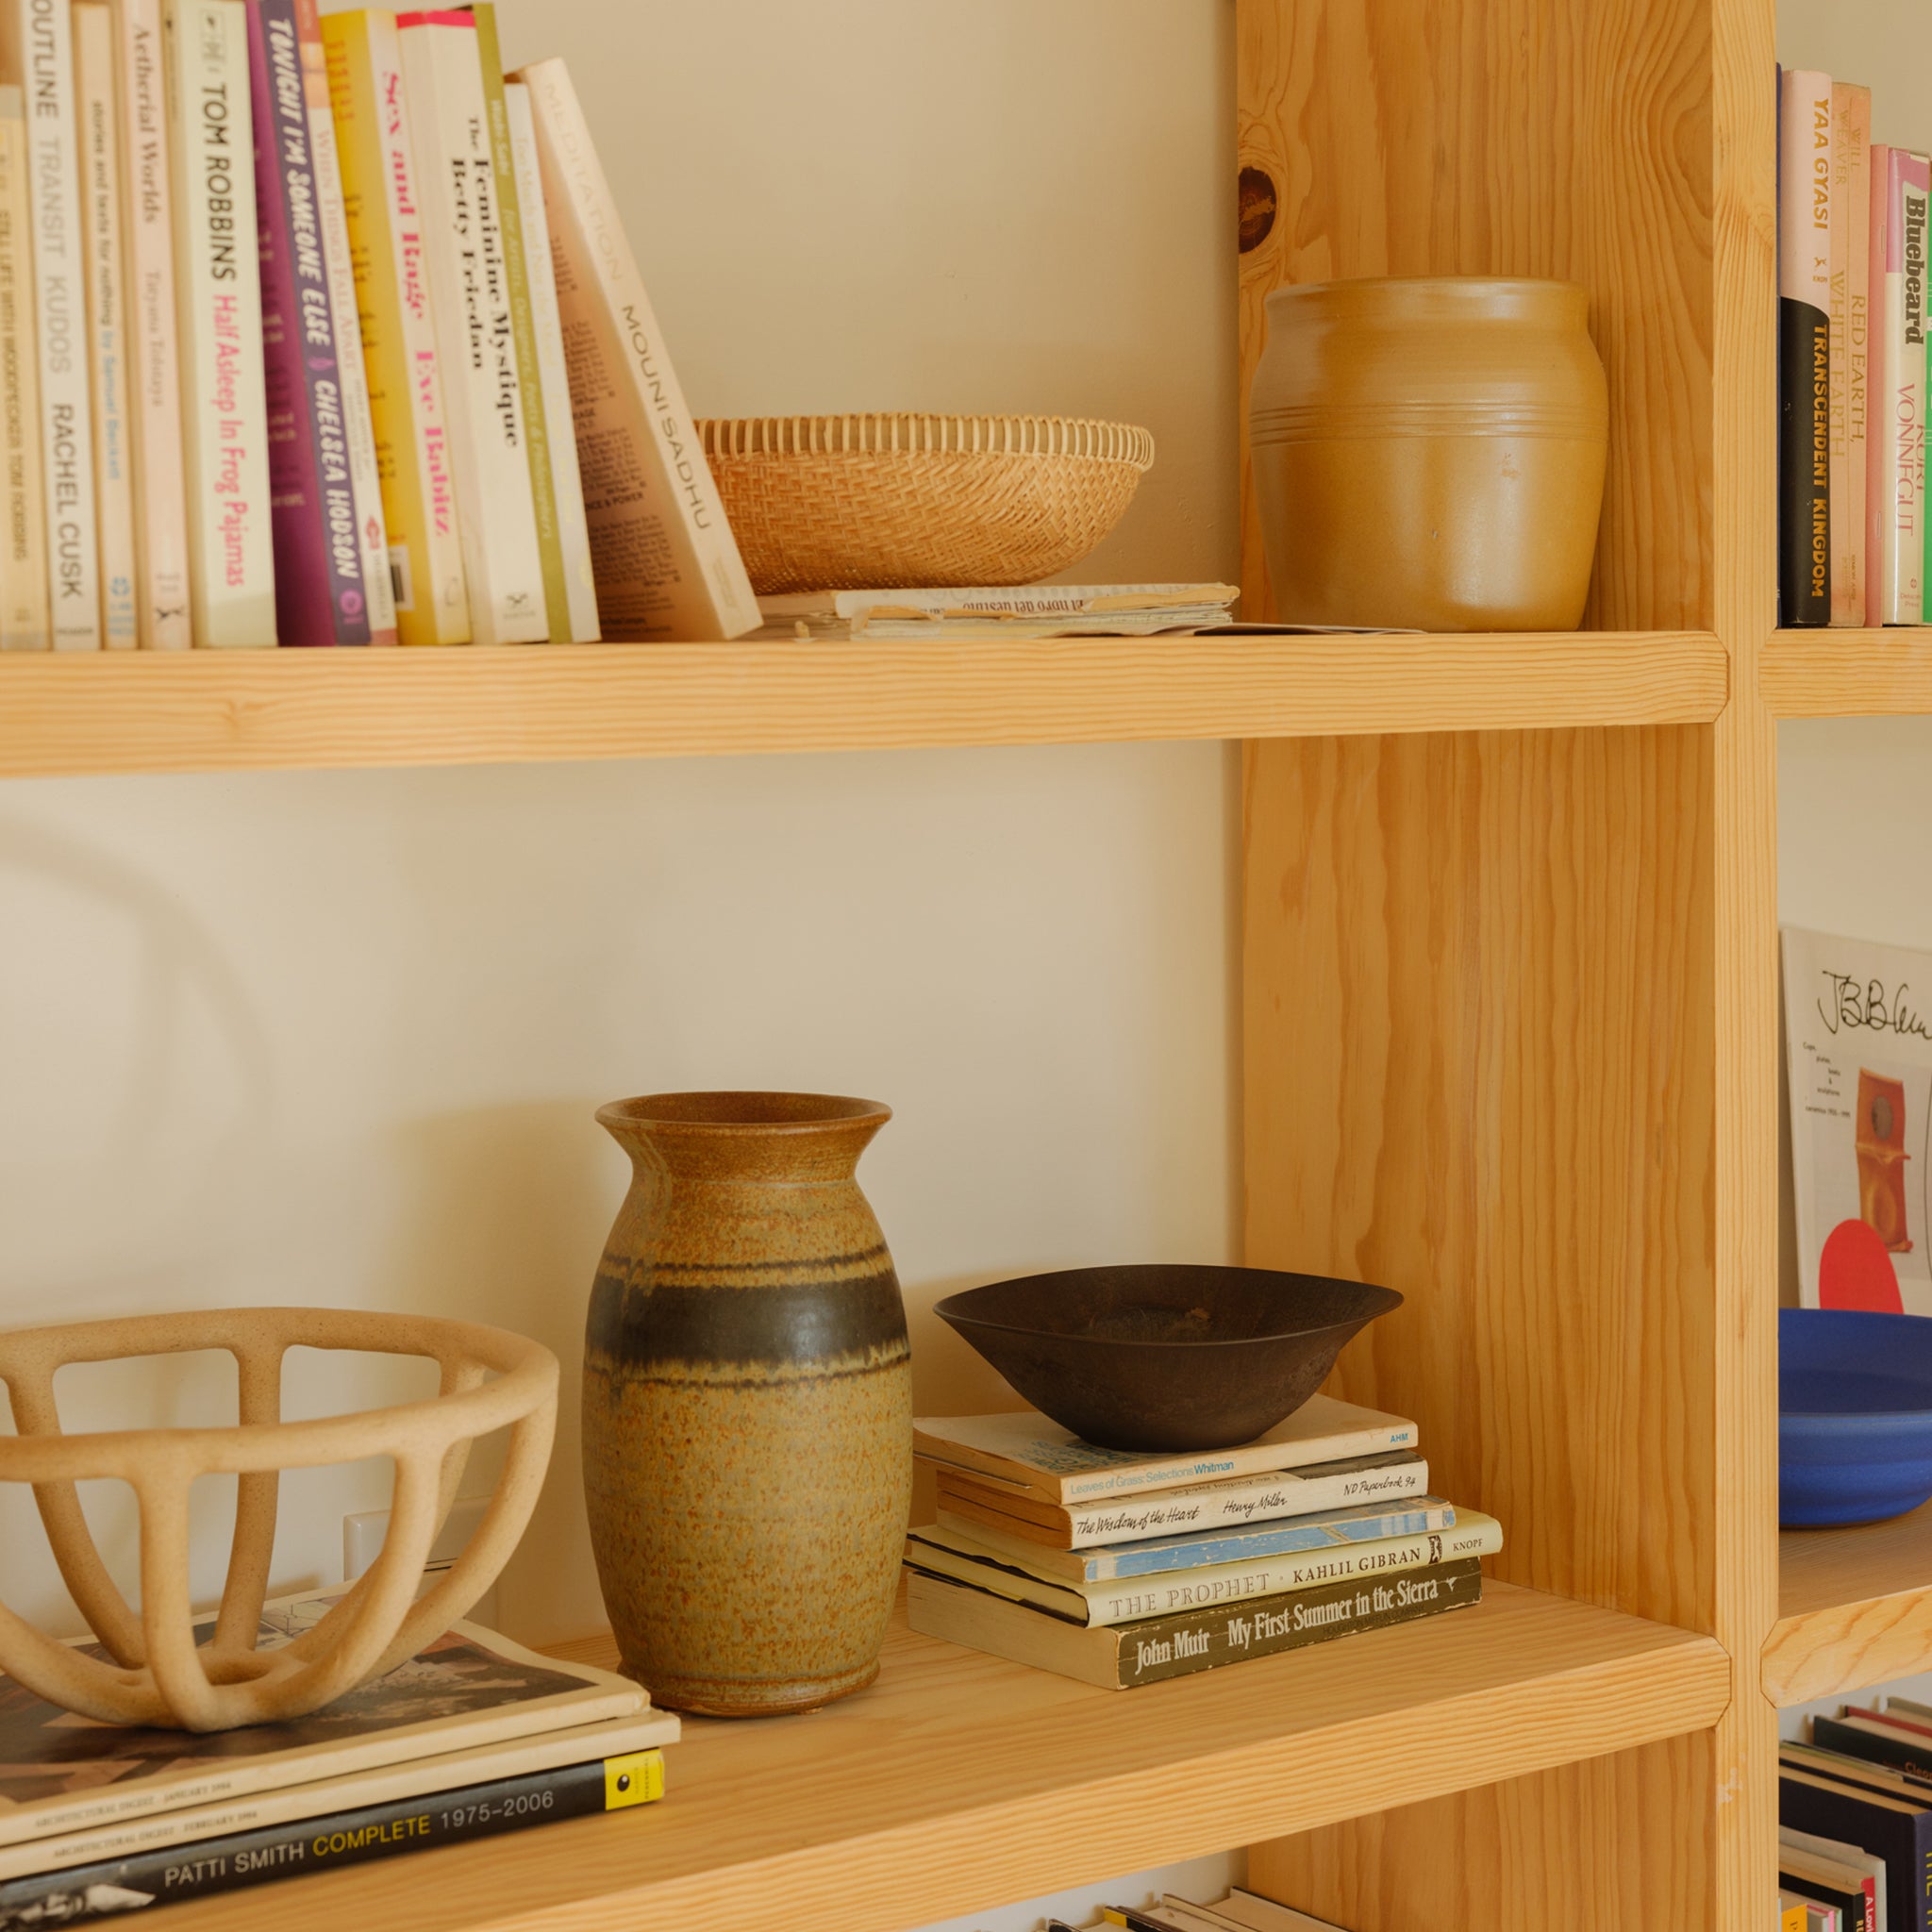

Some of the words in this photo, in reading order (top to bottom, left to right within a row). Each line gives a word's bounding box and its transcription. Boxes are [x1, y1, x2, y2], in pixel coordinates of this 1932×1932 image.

[31, 0, 58, 119] OUTLINE
[133, 25, 158, 135] Aetherial
[267, 19, 303, 131] TONIGHT
[202, 84, 230, 146] TOM
[282, 126, 308, 166] I'M
[382, 71, 402, 135] Sex
[468, 118, 481, 151] The
[1813, 98, 1829, 149] YAA
[143, 139, 163, 225] Worlds
[391, 151, 415, 216] and
[1834, 108, 1849, 186] WEAVER
[1850, 128, 1861, 168] WILL
[39, 138, 66, 259] TRANSIT
[205, 154, 238, 283] ROBBINS
[287, 169, 323, 284] SOMEONE
[451, 158, 472, 239] Betty
[474, 158, 503, 304] Feminine
[1813, 158, 1829, 229] GYASI
[401, 233, 425, 320] Rage
[461, 249, 484, 370] Friedan
[544, 82, 623, 281] MEDITATION
[623, 304, 671, 412] MOUNI
[660, 418, 712, 530] SADHU
[1905, 195, 1926, 344] Bluebeard
[45, 275, 73, 374] KUDOS
[212, 295, 241, 337] Half
[303, 287, 333, 347] ELSE
[1829, 270, 1846, 363] WHITE
[1850, 294, 1867, 347] RED
[211, 341, 242, 413] Asleep
[415, 350, 436, 412] Eve
[488, 309, 519, 448] Mystique
[1812, 325, 1828, 489] TRANSCENDENT
[1830, 371, 1846, 458] EARTH
[1849, 354, 1867, 443] EARTH,
[52, 404, 78, 516] RACHEL
[214, 447, 246, 495] Frog
[219, 420, 245, 441] In
[314, 380, 347, 482] CHELSEA
[1894, 383, 1916, 536] VONNEGUT
[424, 427, 451, 538] Babitz
[58, 523, 84, 598] CUSK
[216, 500, 249, 588] Pajamas
[326, 488, 360, 580] HODSON
[1810, 498, 1827, 598] KINGDOM
[1070, 1480, 1105, 1495] Leaves
[1105, 1480, 1116, 1491] of
[1116, 1473, 1146, 1488] Grass:
[1146, 1466, 1194, 1483] Selections
[1194, 1460, 1234, 1475] Whitman
[1390, 1433, 1408, 1443] AHM
[1076, 1520, 1095, 1535] The
[1095, 1515, 1139, 1533] Wisdom
[1135, 1512, 1148, 1531] of
[1148, 1510, 1166, 1525] the
[1166, 1506, 1201, 1524] Heart
[1223, 1499, 1260, 1518] Henry
[1257, 1494, 1288, 1510] Miller
[1342, 1483, 1358, 1496] ND
[1358, 1476, 1404, 1494] Paperbook
[1403, 1476, 1416, 1488] 94
[1108, 1592, 1158, 1619] THE
[1166, 1573, 1270, 1608] PROPHET
[1292, 1560, 1355, 1585] KAHLIL
[1358, 1547, 1422, 1571] GIBRAN
[1452, 1538, 1484, 1552] KNOPF
[1135, 1640, 1171, 1675] John
[1174, 1627, 1210, 1657] Muir
[1227, 1614, 1254, 1651] My
[1254, 1609, 1291, 1641] First
[1292, 1597, 1354, 1631] Summer
[1356, 1591, 1372, 1616] in
[1372, 1585, 1395, 1611] the
[1396, 1577, 1440, 1606] Sierra
[164, 1857, 226, 1888] PATTI
[234, 1840, 305, 1874] SMITH
[312, 1814, 431, 1857] COMPLETE
[1865, 1896, 1874, 1907] A
